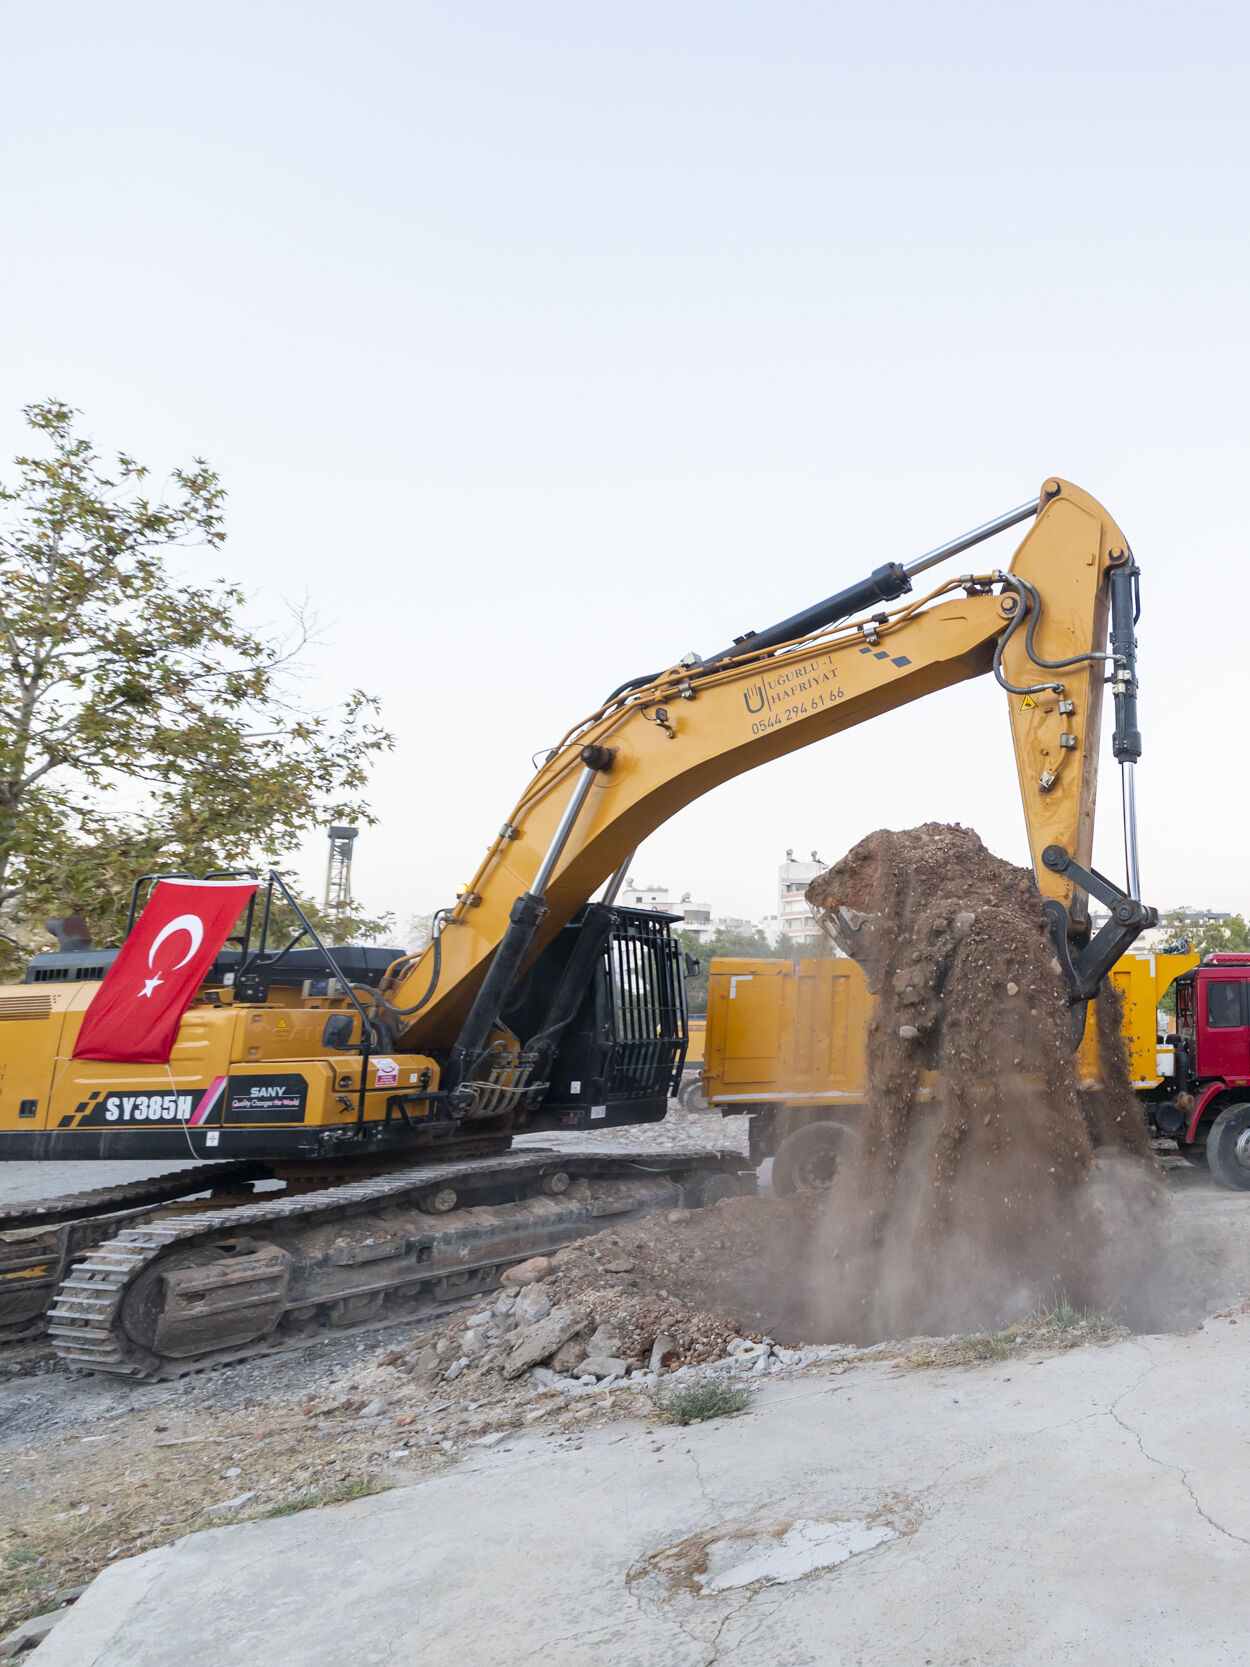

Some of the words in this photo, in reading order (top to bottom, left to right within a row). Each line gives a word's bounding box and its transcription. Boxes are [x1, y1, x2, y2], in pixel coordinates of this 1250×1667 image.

[768, 660, 819, 690] UĞURLU
[771, 667, 838, 704] HAFRİYAT
[751, 713, 782, 735] 0544
[784, 702, 808, 721] 294
[811, 695, 825, 710] 61
[829, 686, 845, 702] 66
[249, 1086, 287, 1098] SANY
[104, 1095, 193, 1121] SY385H
